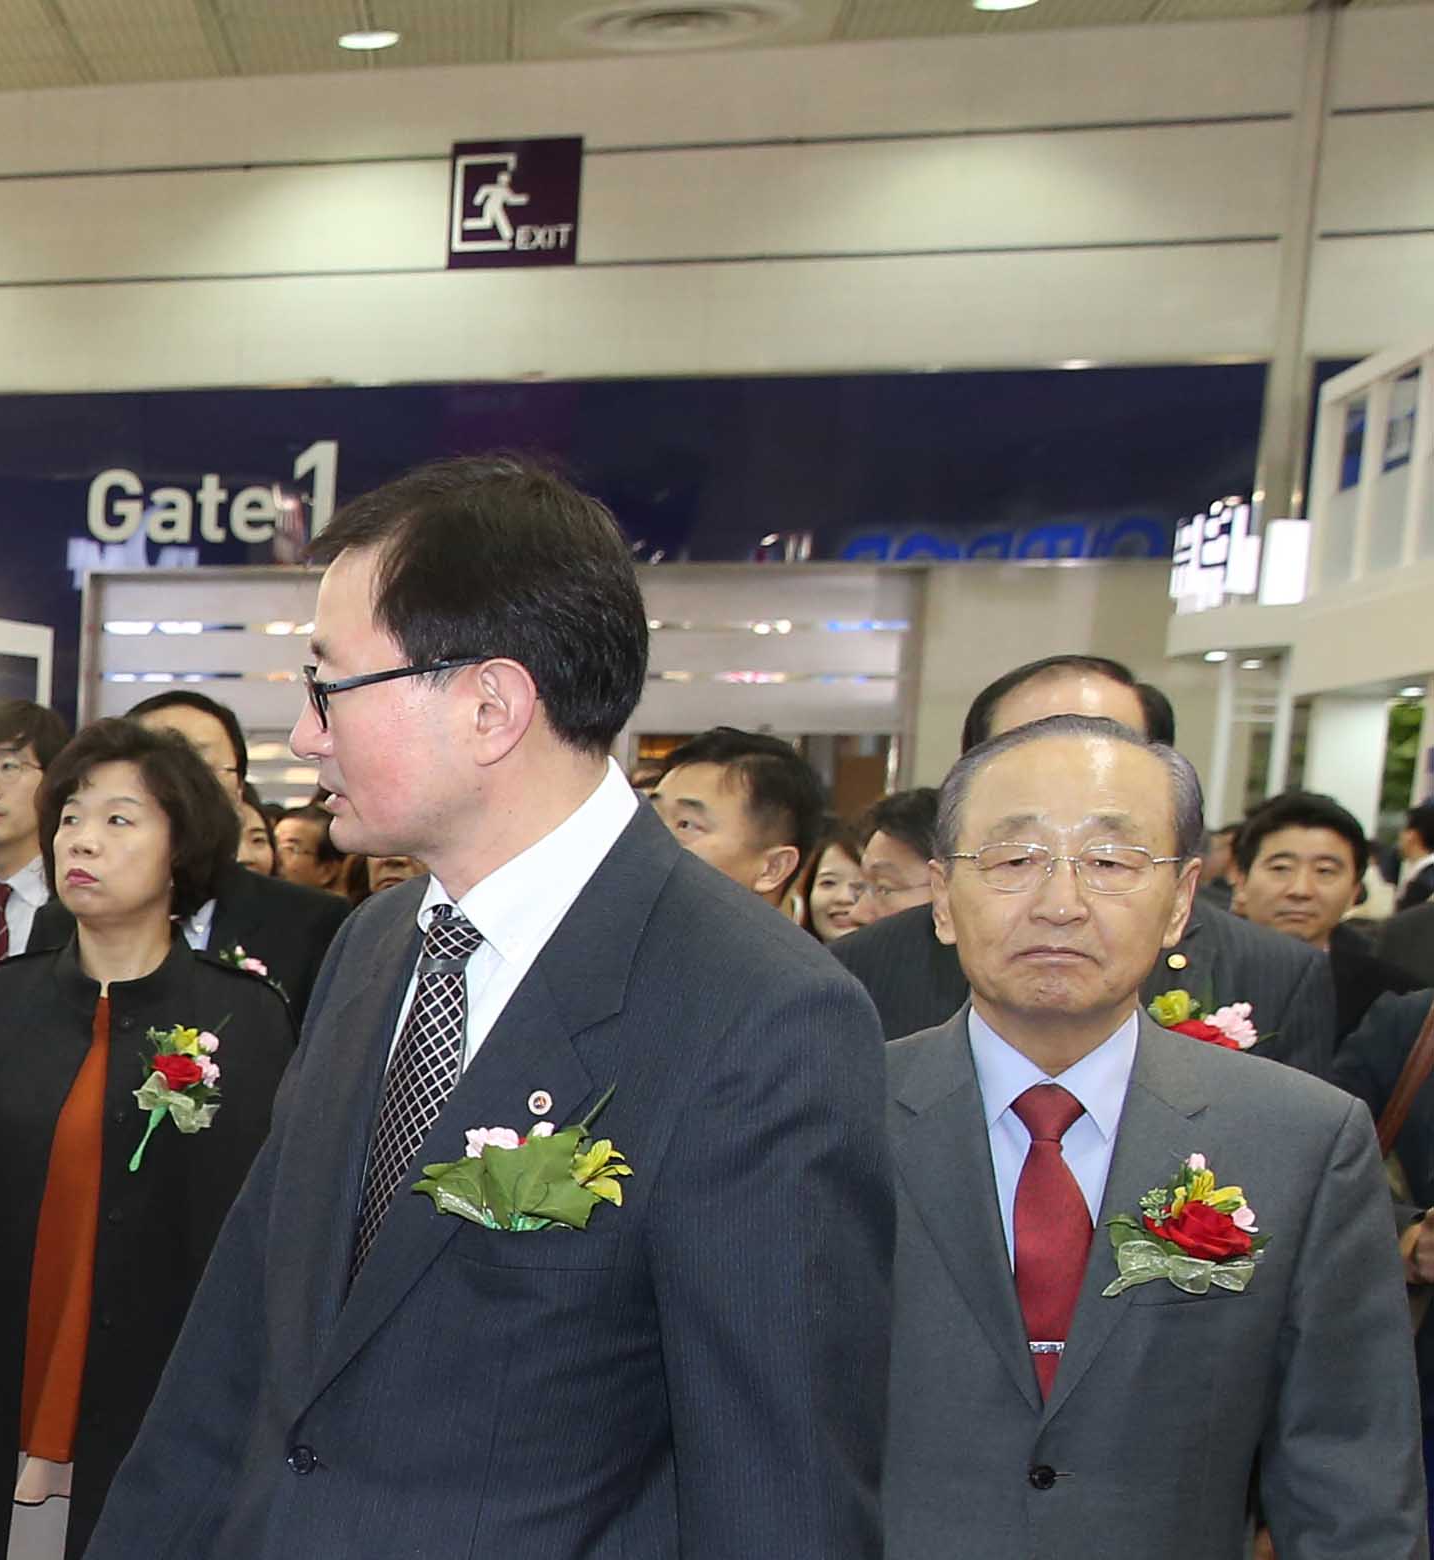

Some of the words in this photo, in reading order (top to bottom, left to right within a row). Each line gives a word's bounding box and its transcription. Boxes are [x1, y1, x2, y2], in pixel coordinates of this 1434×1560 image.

[515, 222, 573, 250] EXIT
[87, 468, 275, 544] Gate
[293, 439, 339, 542] 1
